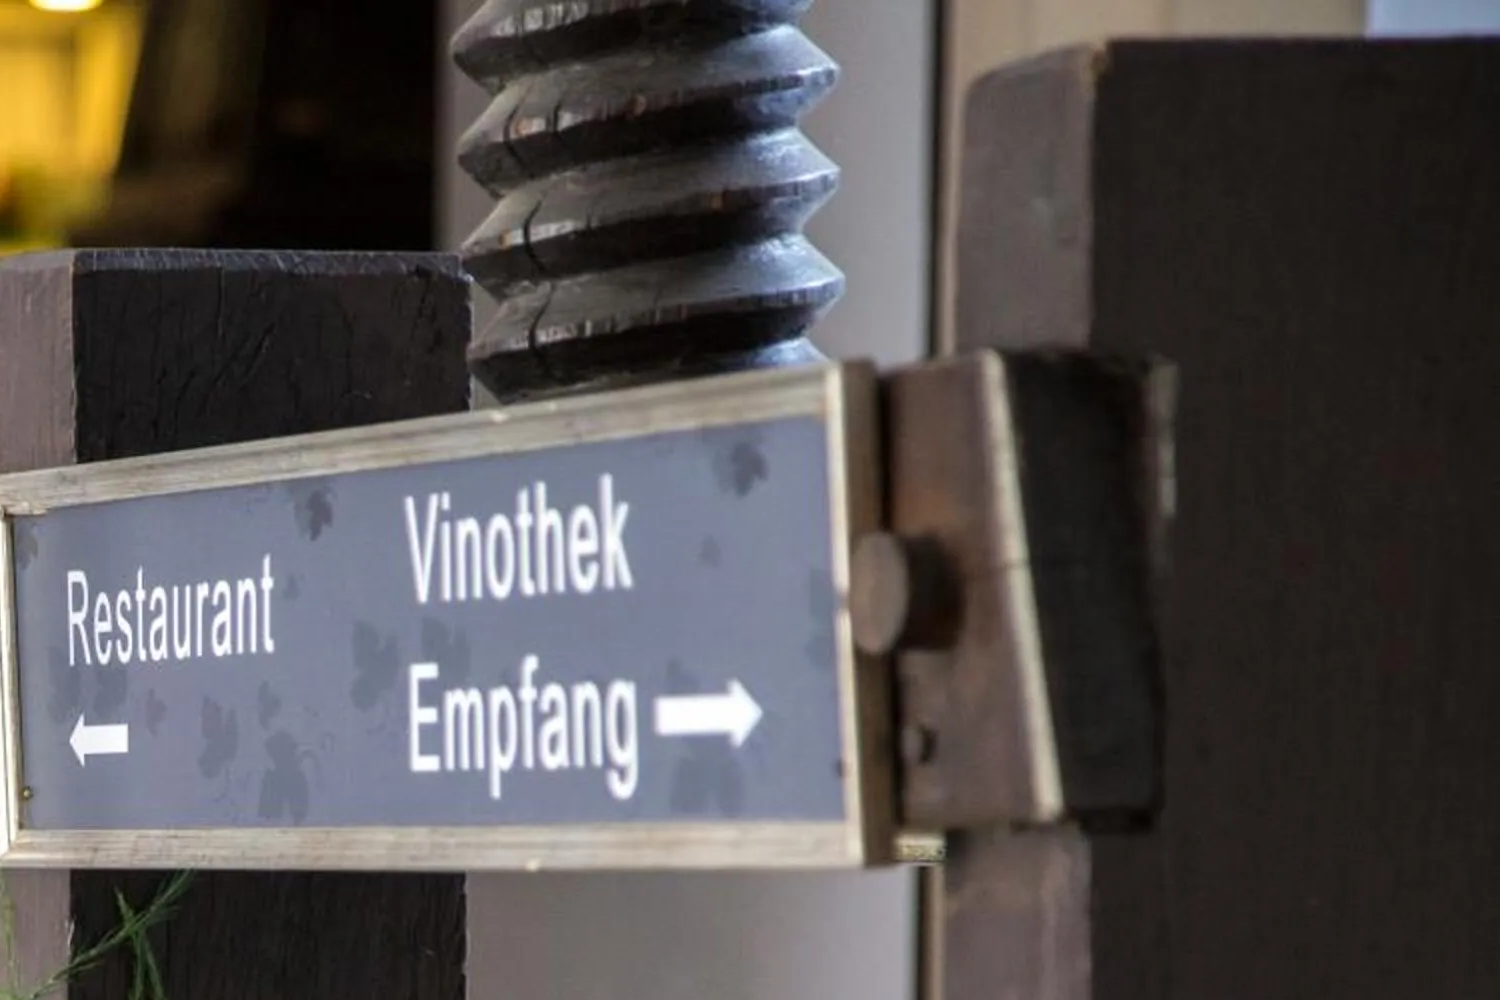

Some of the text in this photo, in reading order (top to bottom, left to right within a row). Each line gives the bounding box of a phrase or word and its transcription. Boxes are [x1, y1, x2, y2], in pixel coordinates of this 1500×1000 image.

[403, 473, 634, 604] Vinothek
[66, 553, 275, 668] Restaurant
[408, 652, 639, 801] Empfang
